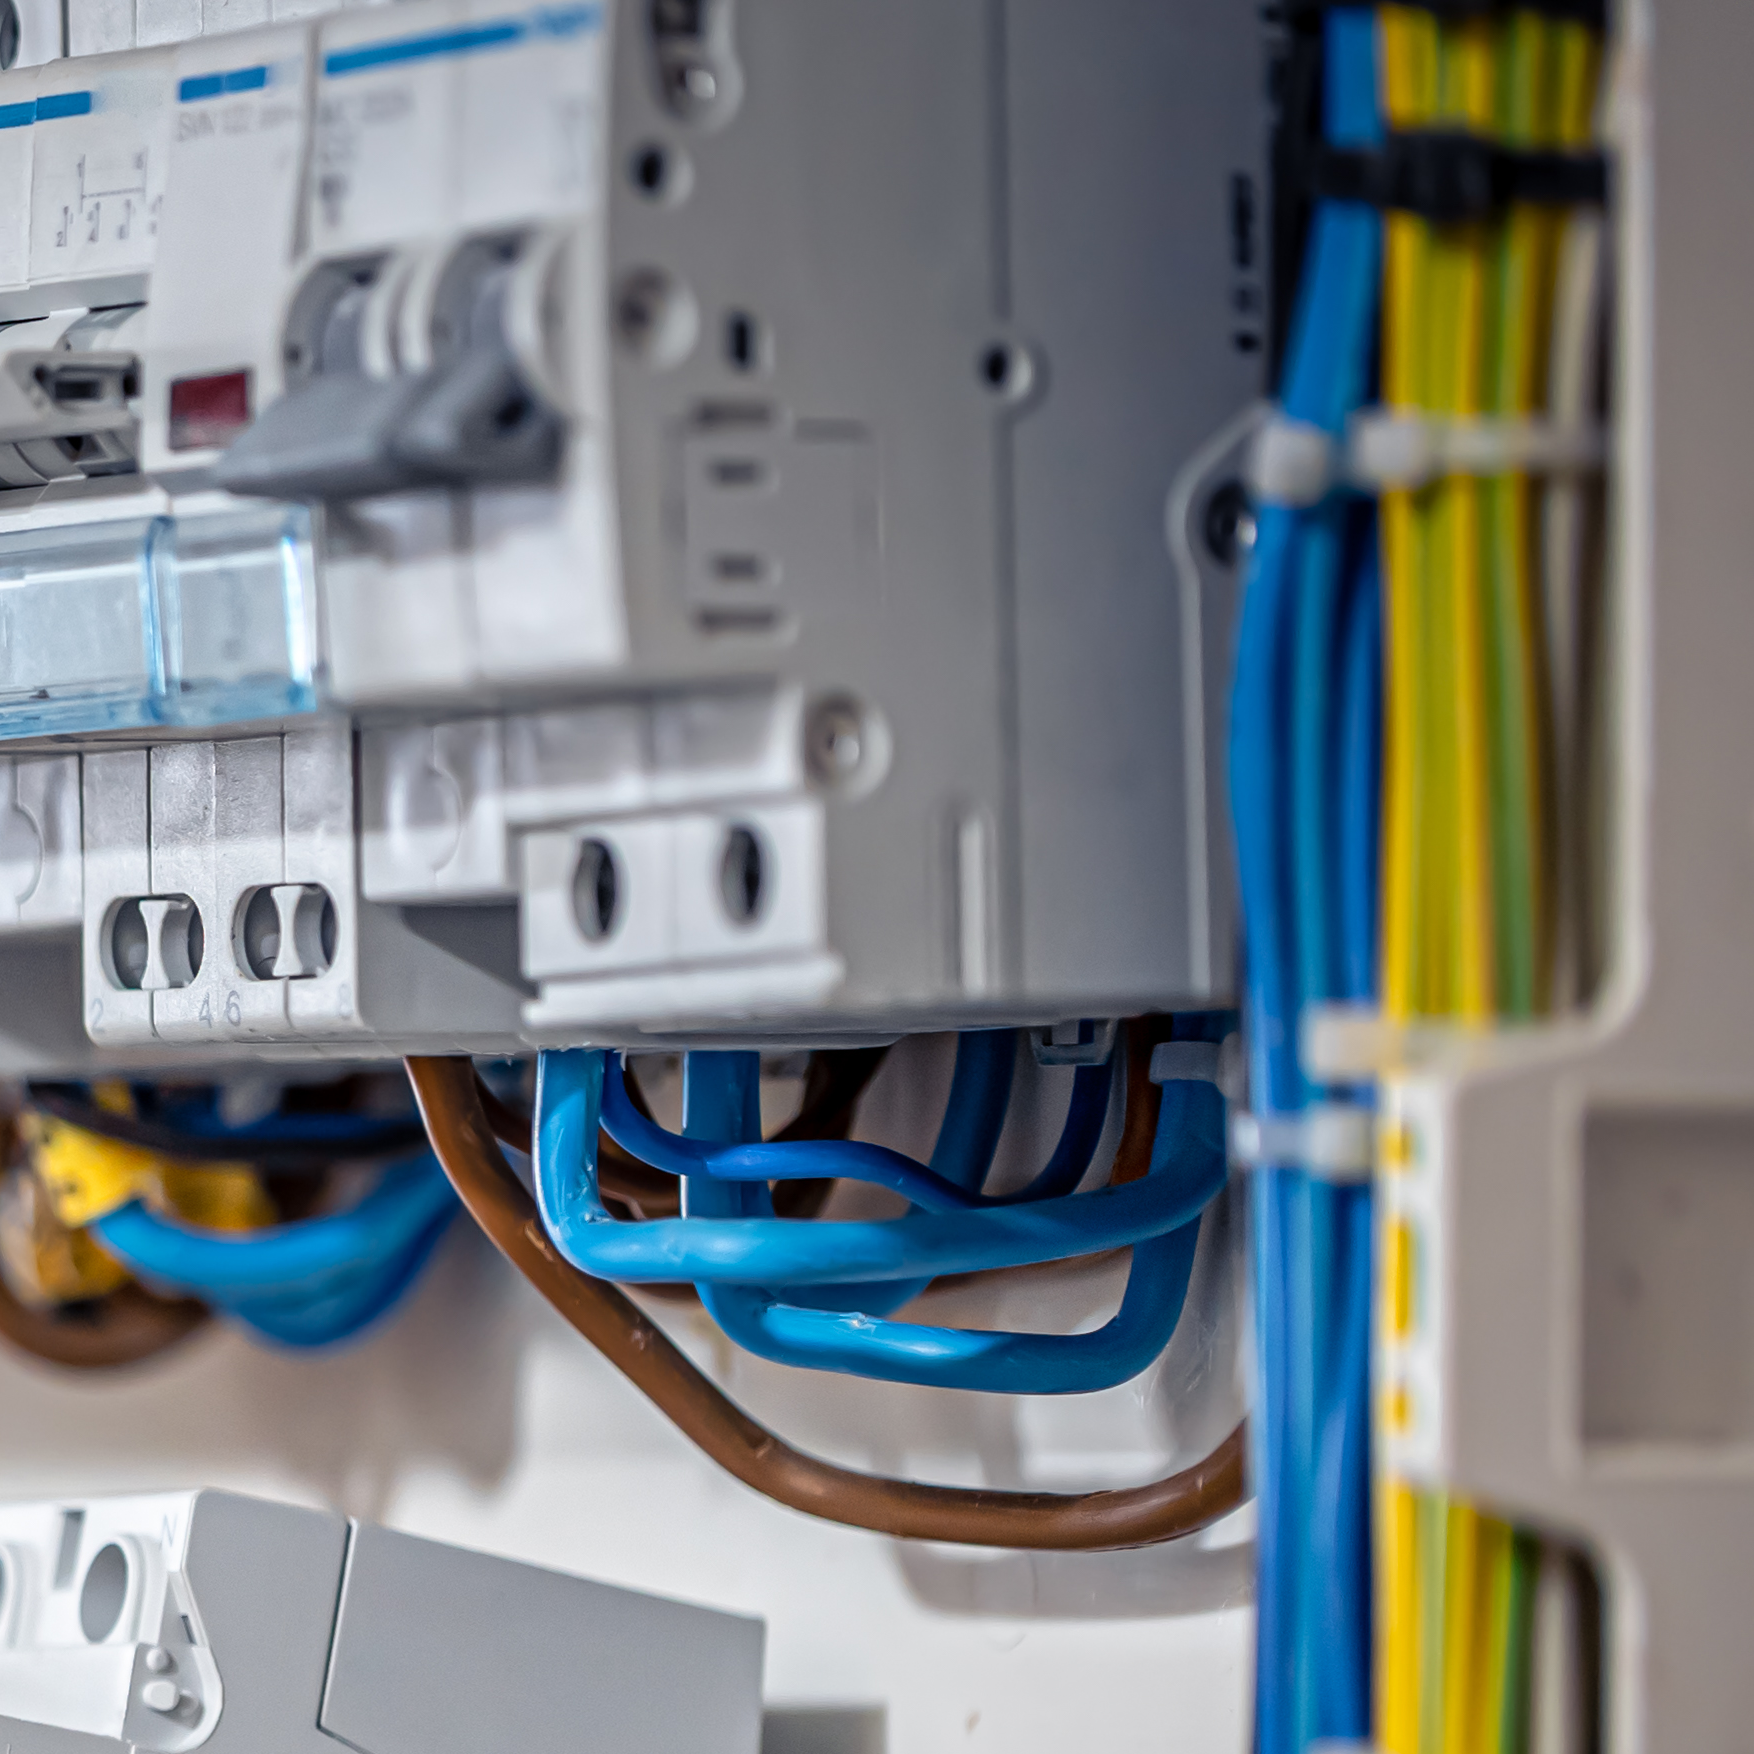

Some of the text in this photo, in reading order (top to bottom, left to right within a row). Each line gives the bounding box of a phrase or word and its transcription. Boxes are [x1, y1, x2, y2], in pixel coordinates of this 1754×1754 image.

[199, 992, 212, 1029] 4
[225, 990, 241, 1026] 6
[159, 1512, 178, 1552] N
